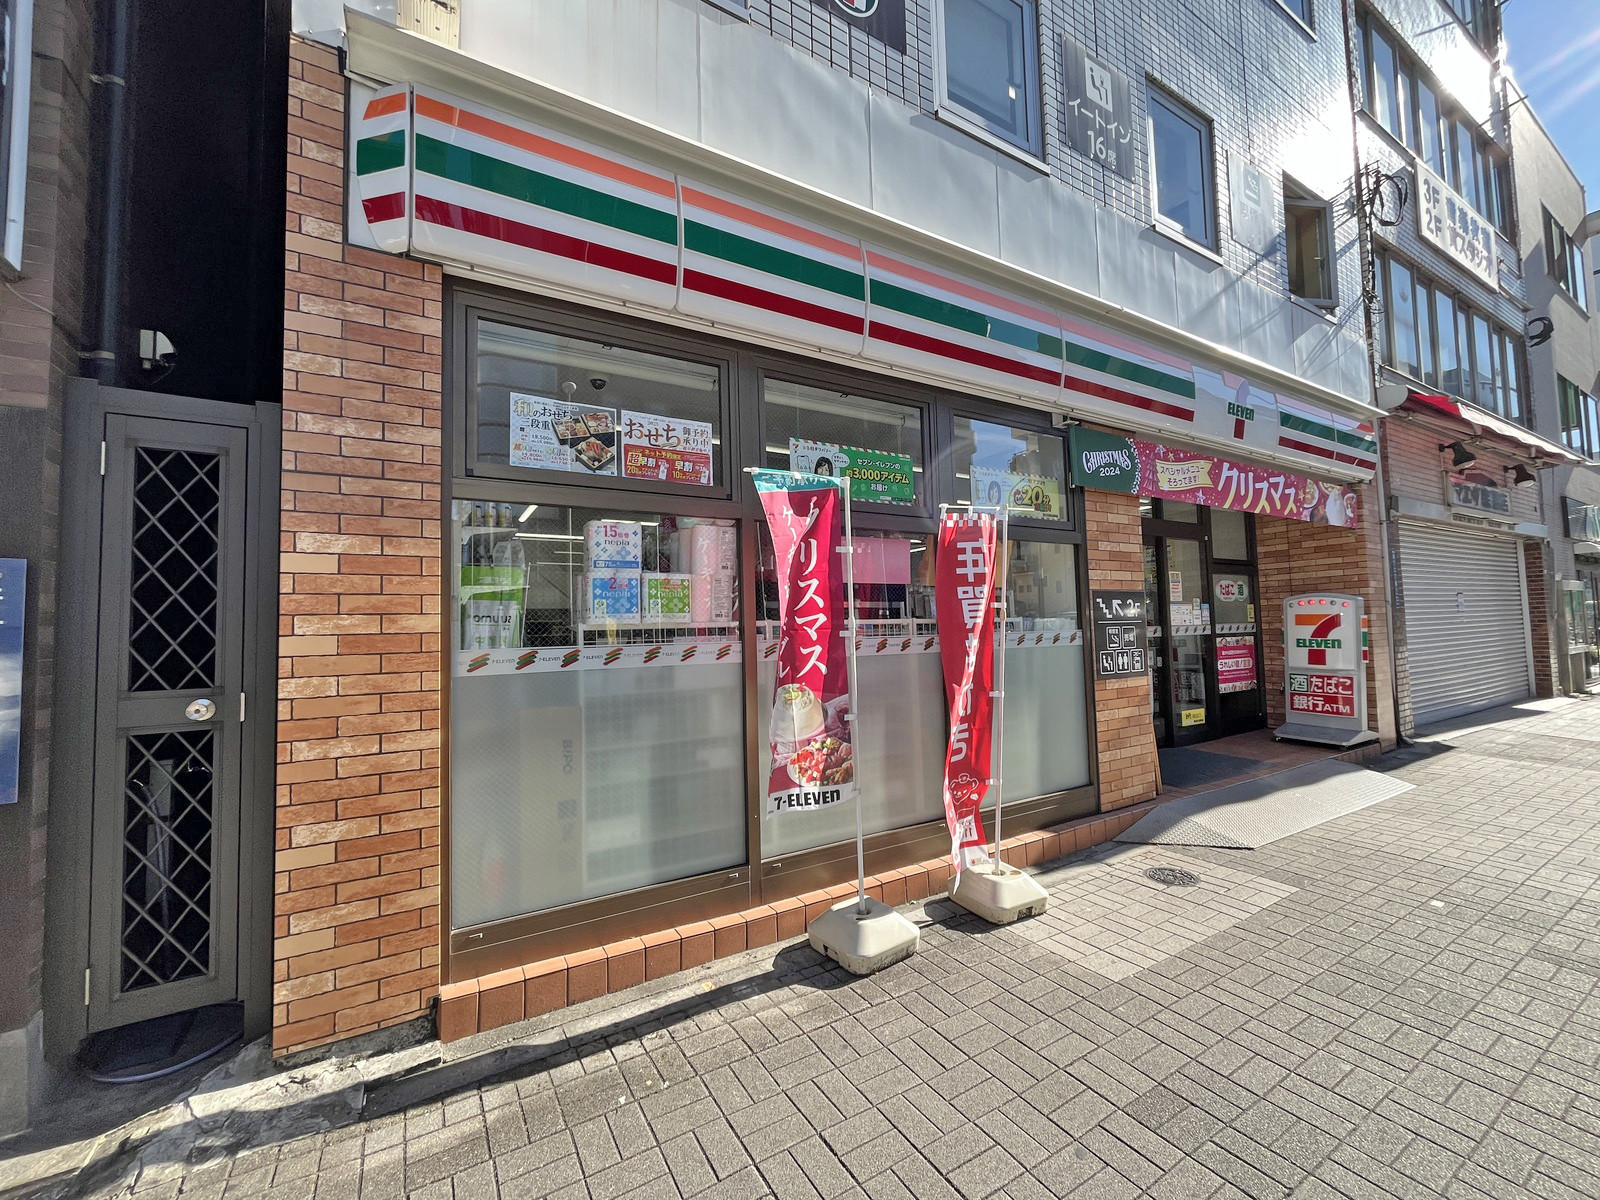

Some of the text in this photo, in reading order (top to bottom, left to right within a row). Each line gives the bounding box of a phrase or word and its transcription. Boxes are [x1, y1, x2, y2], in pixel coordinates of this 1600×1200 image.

[1068, 98, 1132, 144] イートイン
[1423, 178, 1440, 210] 3F
[1425, 207, 1442, 238] 2F
[624, 418, 682, 449] おせち
[1082, 449, 1132, 474] CHRISTMAS
[1100, 467, 1120, 477] 2024
[1217, 462, 1297, 516] クリスマス
[1126, 599, 1141, 618] 2F
[1290, 674, 1308, 691] 酒
[1310, 676, 1352, 694] たばこ
[1292, 694, 1351, 714] 銀行ATM
